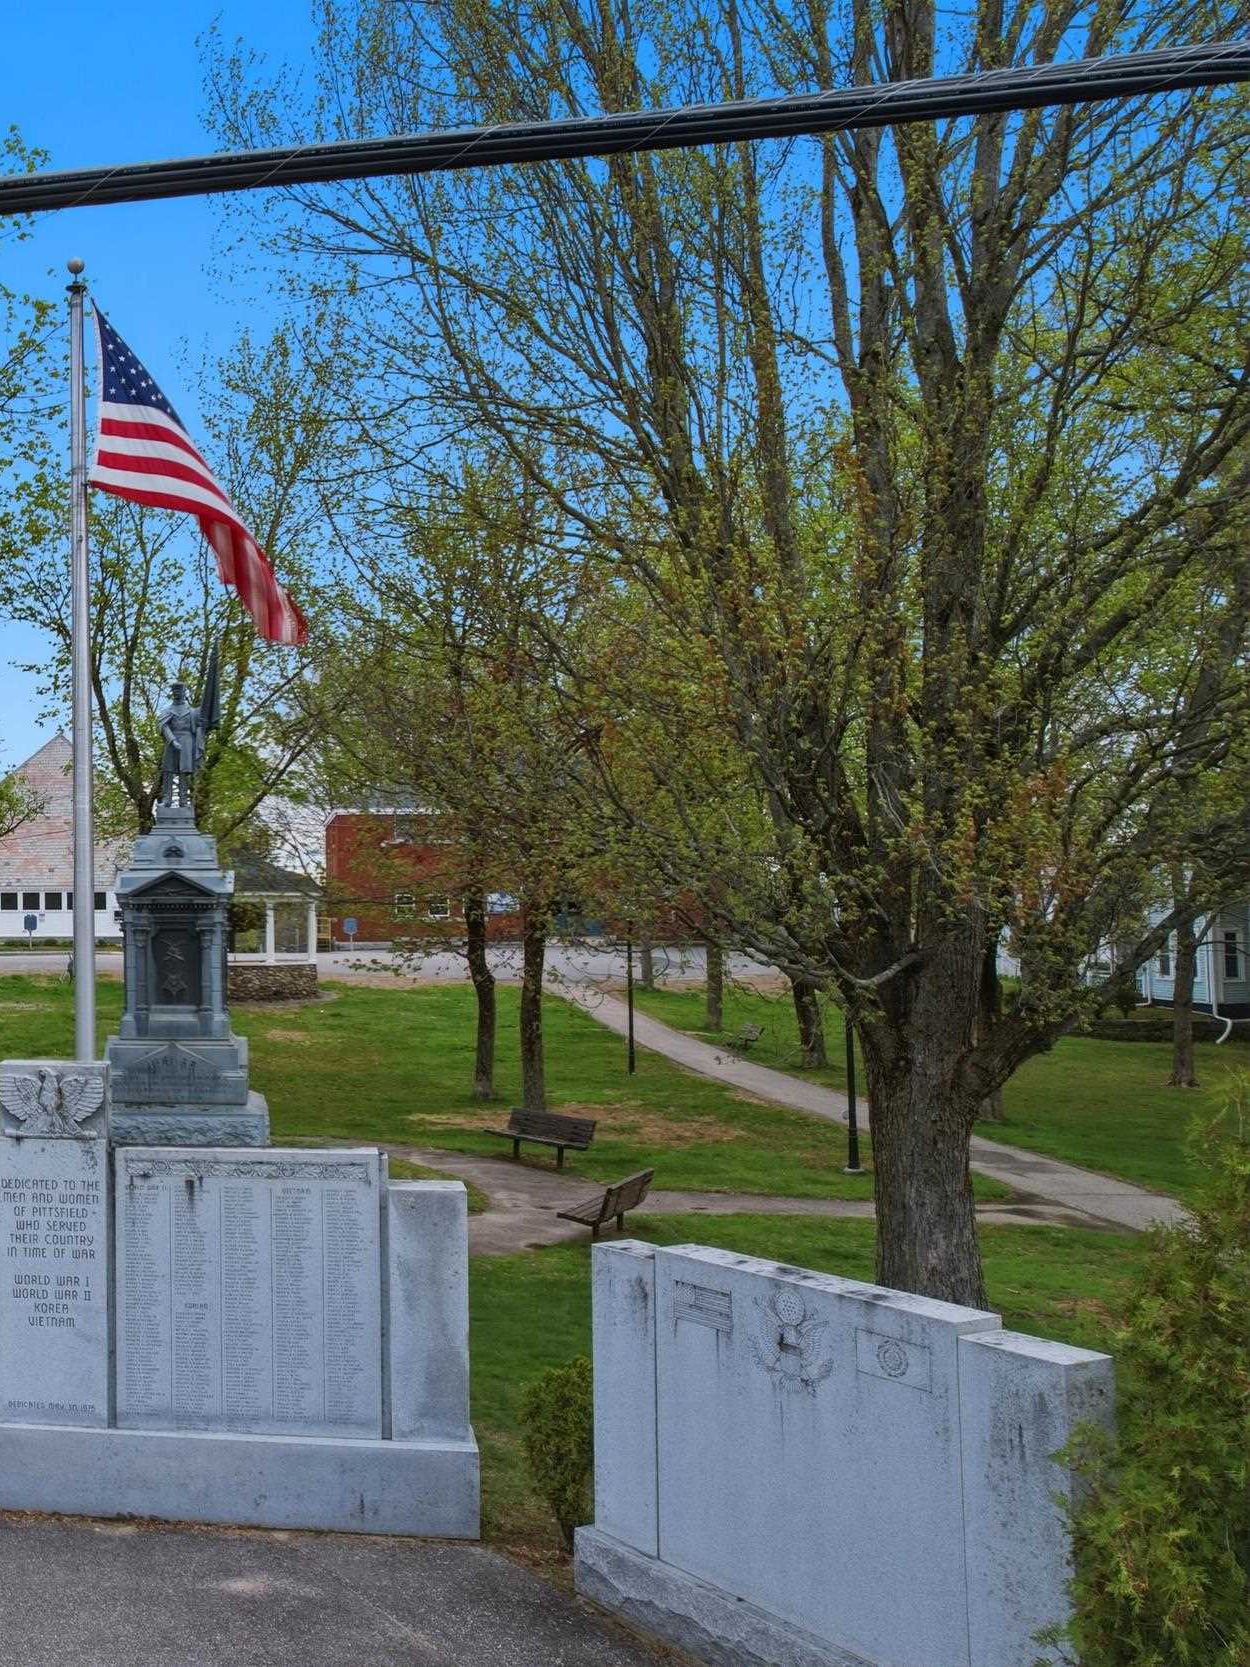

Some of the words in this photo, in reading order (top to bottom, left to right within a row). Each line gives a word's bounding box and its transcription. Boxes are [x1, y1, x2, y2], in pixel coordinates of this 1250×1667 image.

[1, 1179, 58, 1190] DEDICATED
[64, 1180, 76, 1191] TO
[81, 1180, 100, 1192] THE
[3, 1192, 26, 1203] MEN
[32, 1193, 53, 1204] AND
[59, 1194, 99, 1205] WOMEN
[14, 1206, 26, 1217] OF
[32, 1207, 88, 1219] PITTSFIELD
[16, 1220, 40, 1231] WHO
[47, 1221, 87, 1232] SERVED
[10, 1233, 39, 1244] THEIR
[45, 1234, 94, 1246] COUNTRY
[7, 1247, 17, 1257] IN
[24, 1247, 47, 1258] TIME
[54, 1248, 66, 1259] OF
[72, 1249, 95, 1260] WAR
[14, 1274, 50, 1285] WORLD
[56, 1275, 80, 1286] WAR
[85, 1276, 90, 1287] I
[13, 1288, 48, 1299] WORLD
[54, 1289, 78, 1300] WAR
[84, 1290, 91, 1301] II
[34, 1302, 69, 1314] KOREA
[28, 1316, 75, 1328] VIETNAM
